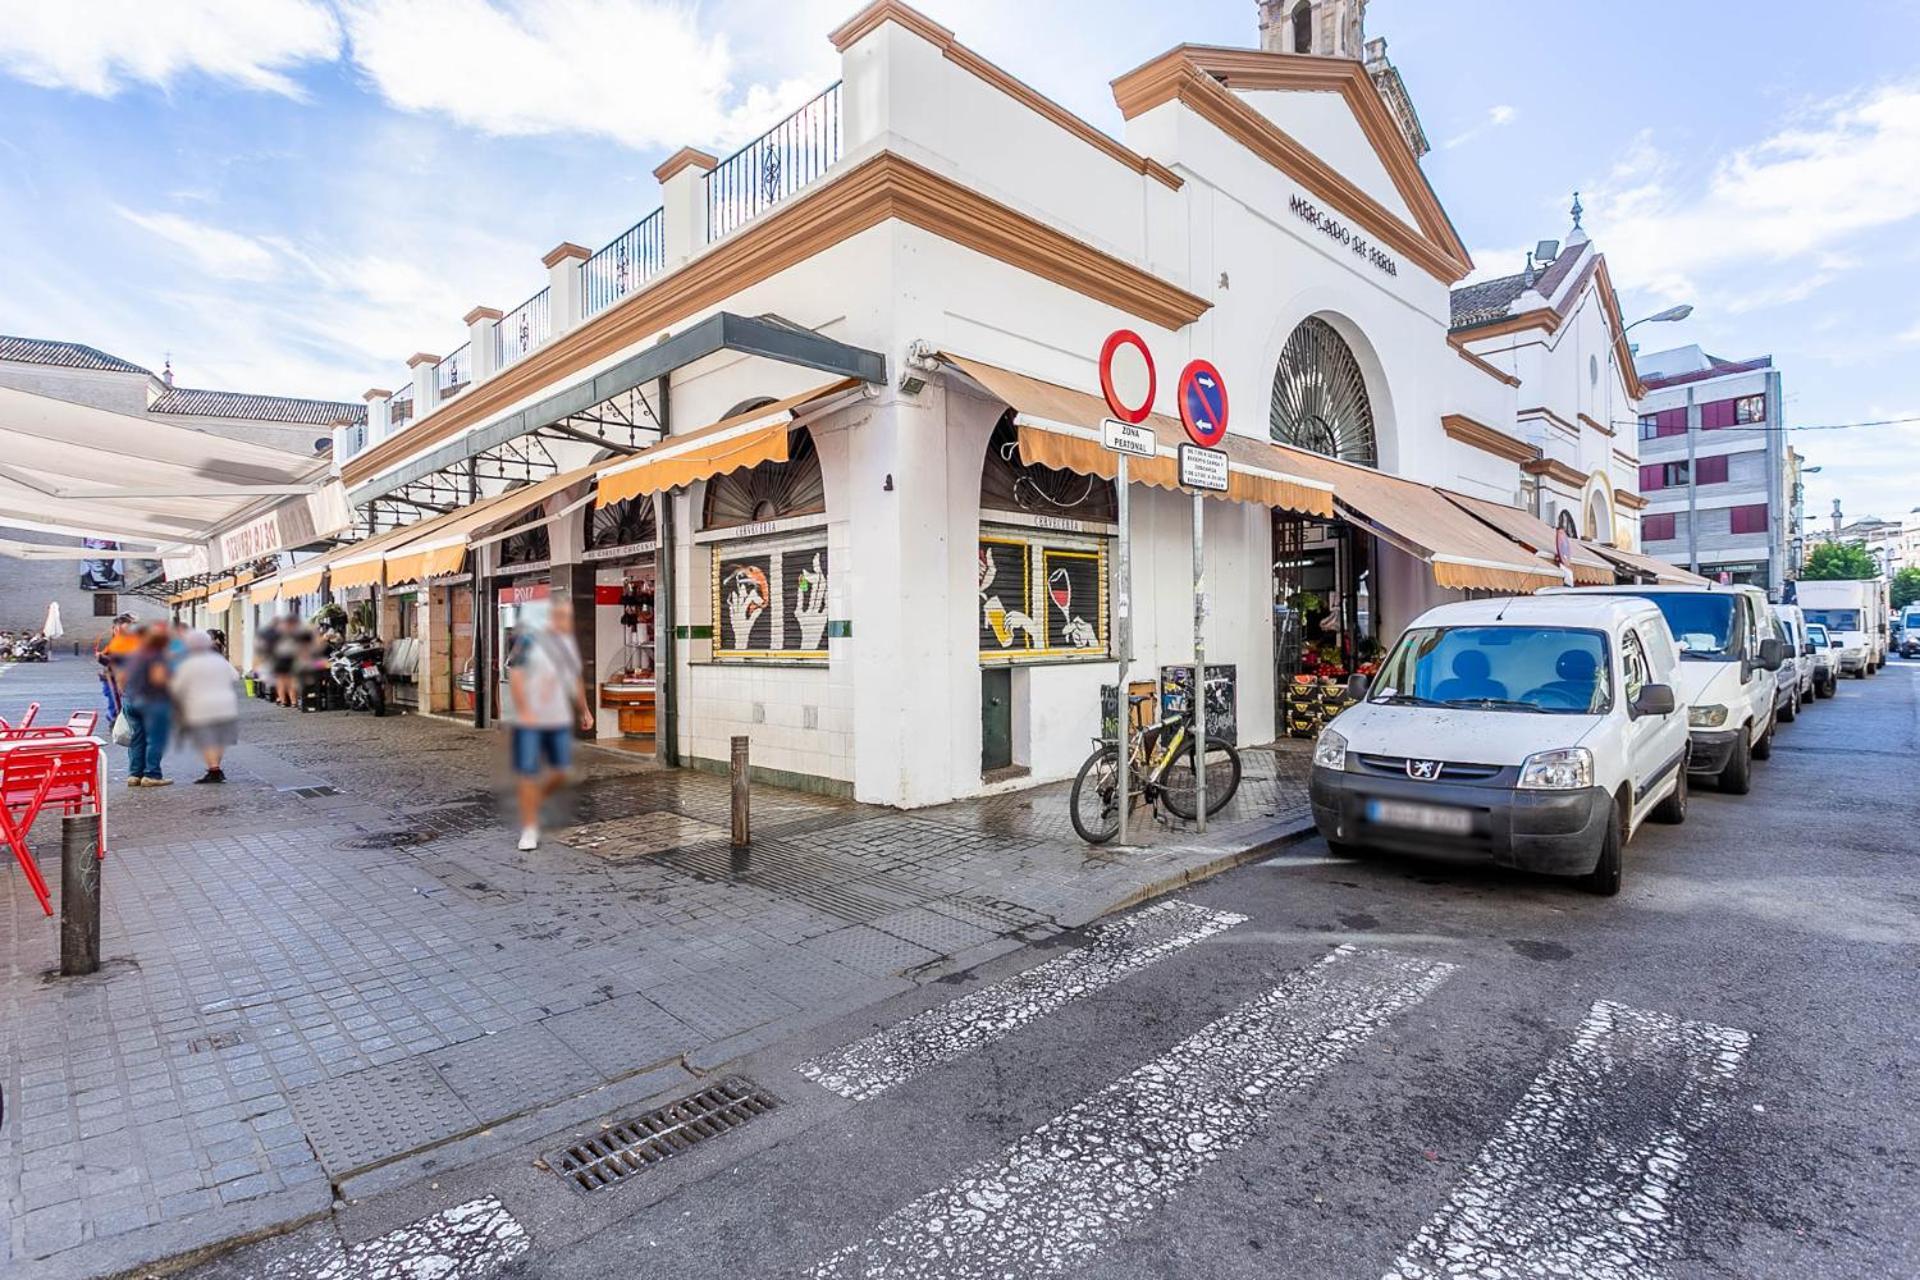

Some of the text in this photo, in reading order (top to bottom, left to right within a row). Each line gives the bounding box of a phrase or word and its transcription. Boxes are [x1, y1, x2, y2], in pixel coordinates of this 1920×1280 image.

[1289, 193, 1350, 245] MERCADO
[1121, 426, 1140, 438] ZONA
[1114, 437, 1147, 453] PEATONAL
